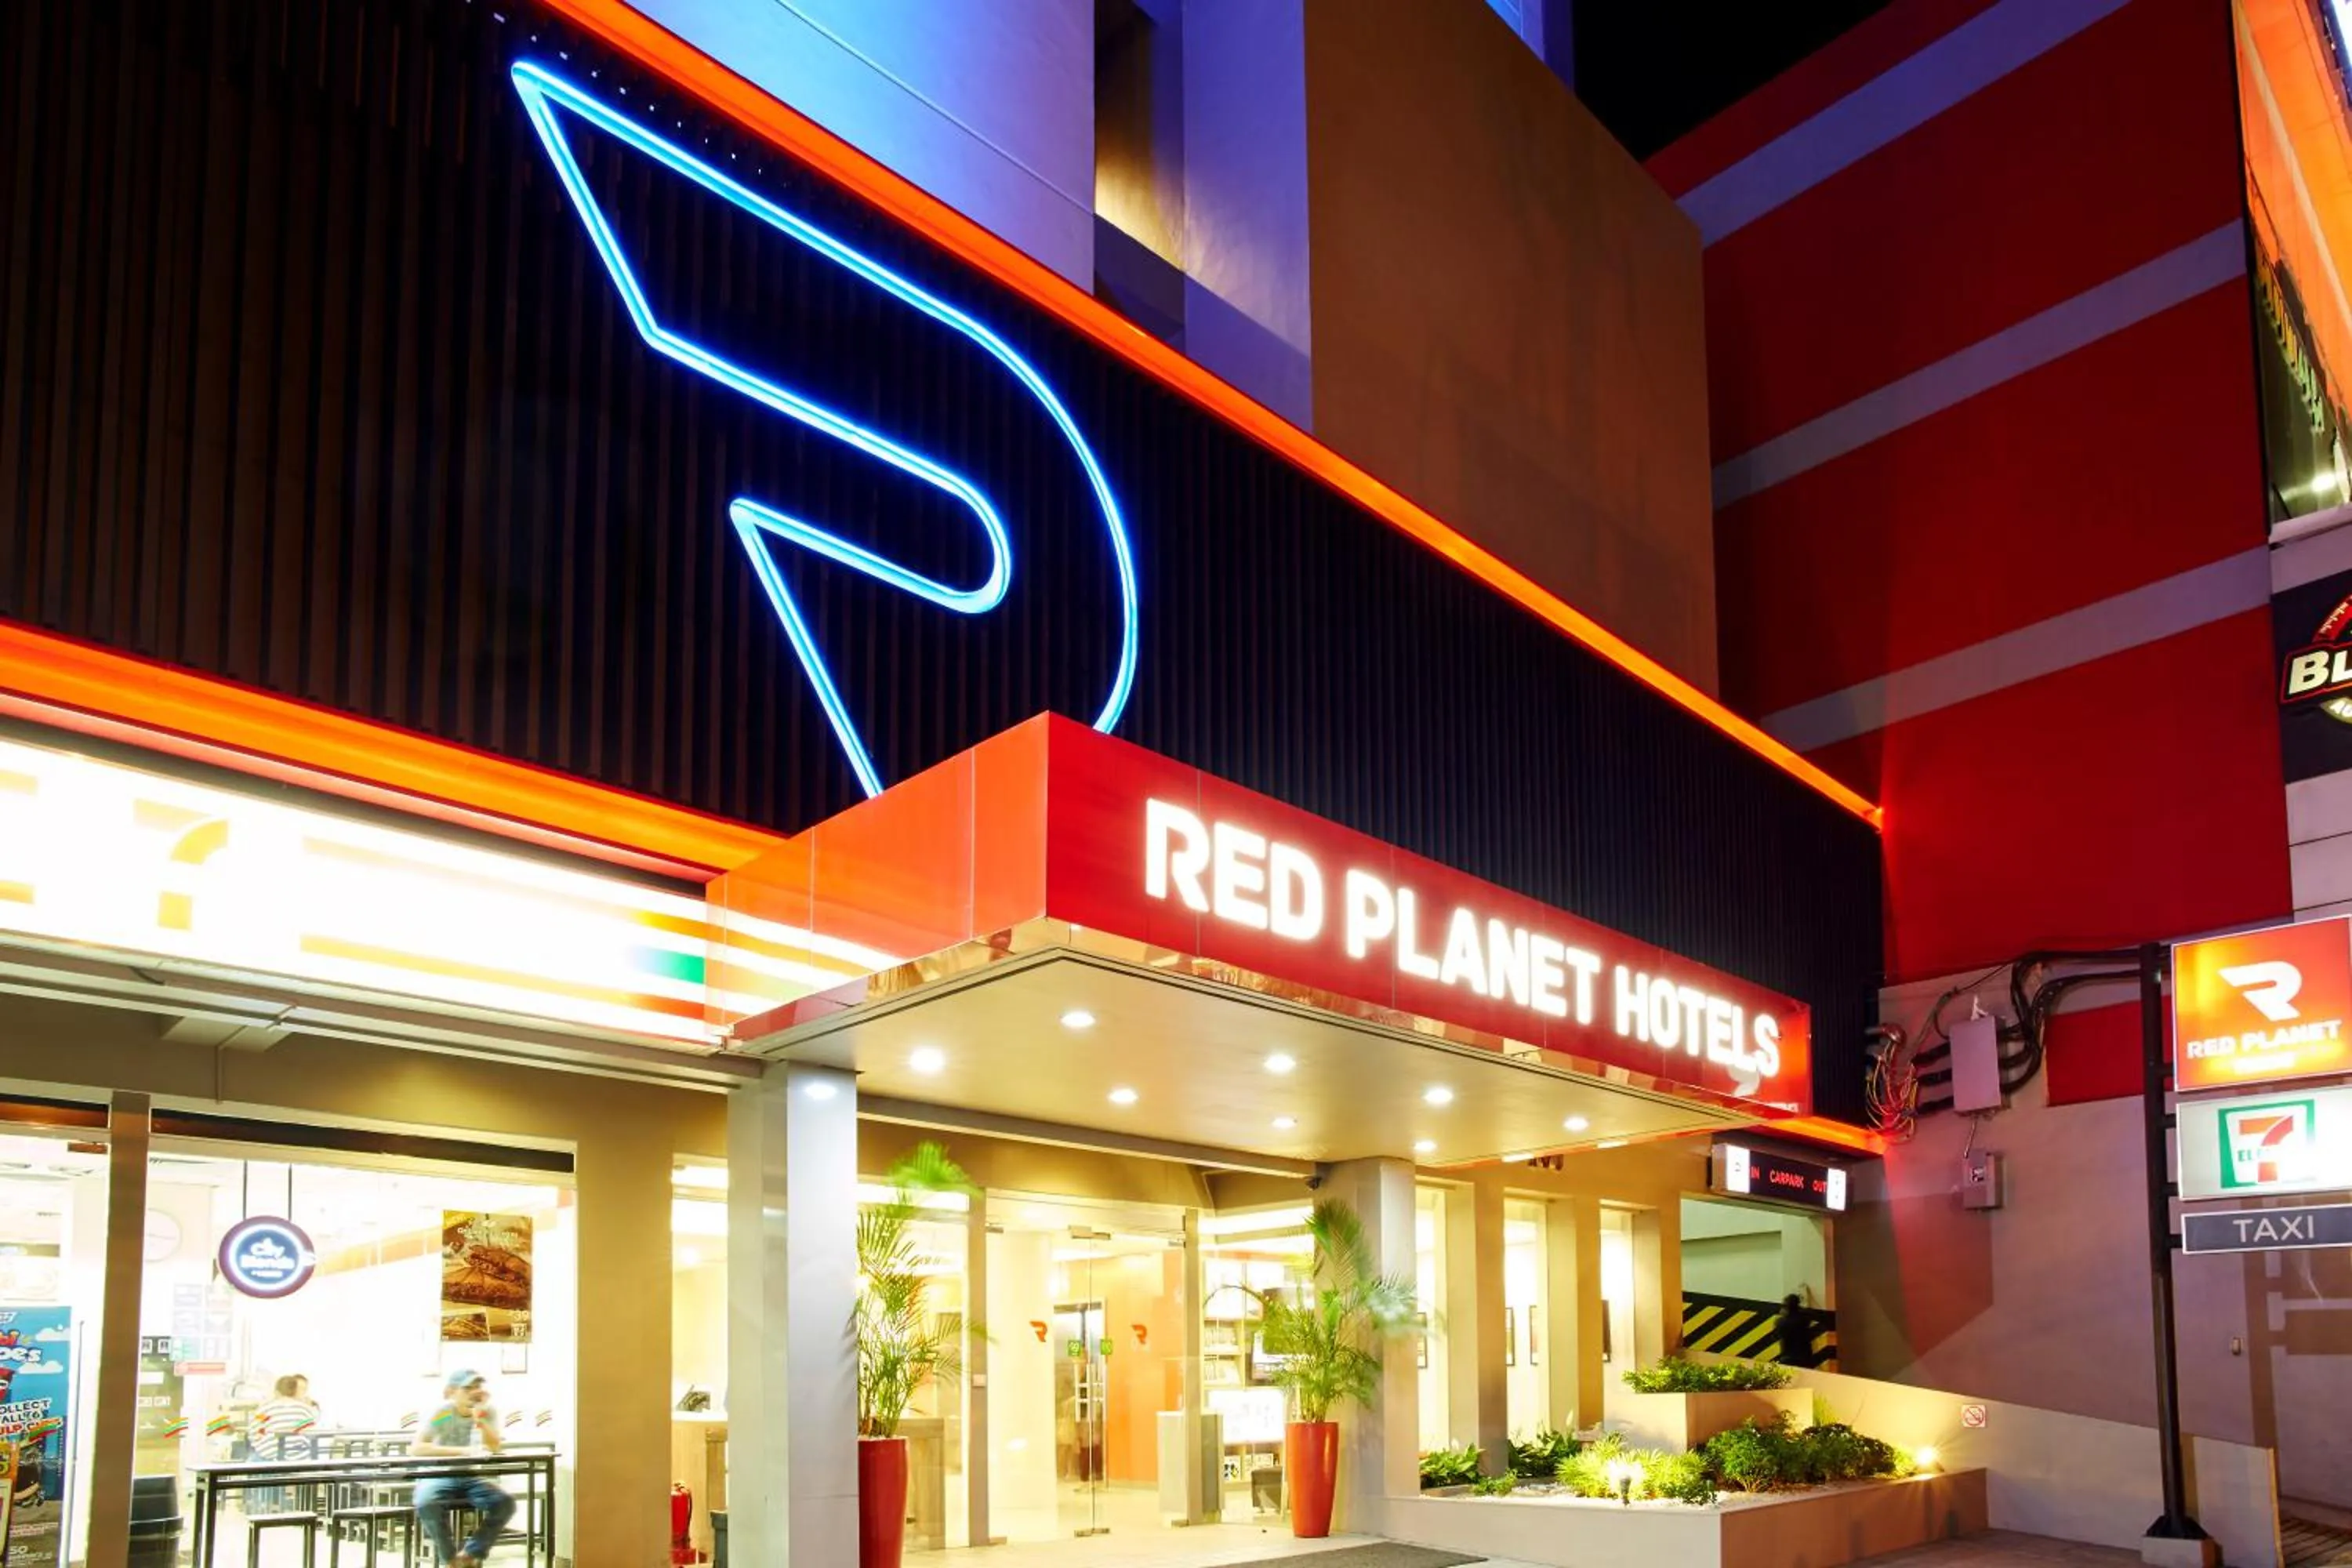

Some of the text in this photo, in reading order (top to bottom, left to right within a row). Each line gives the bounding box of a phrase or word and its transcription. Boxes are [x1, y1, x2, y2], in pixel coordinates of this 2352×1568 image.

[1144, 797, 1780, 1077] RED PLANET HOTELS
[2187, 1019, 2342, 1058] RED PLANET
[1751, 1166, 1828, 1192] IN CARPARK OUT
[2233, 1215, 2314, 1243] TAXI
